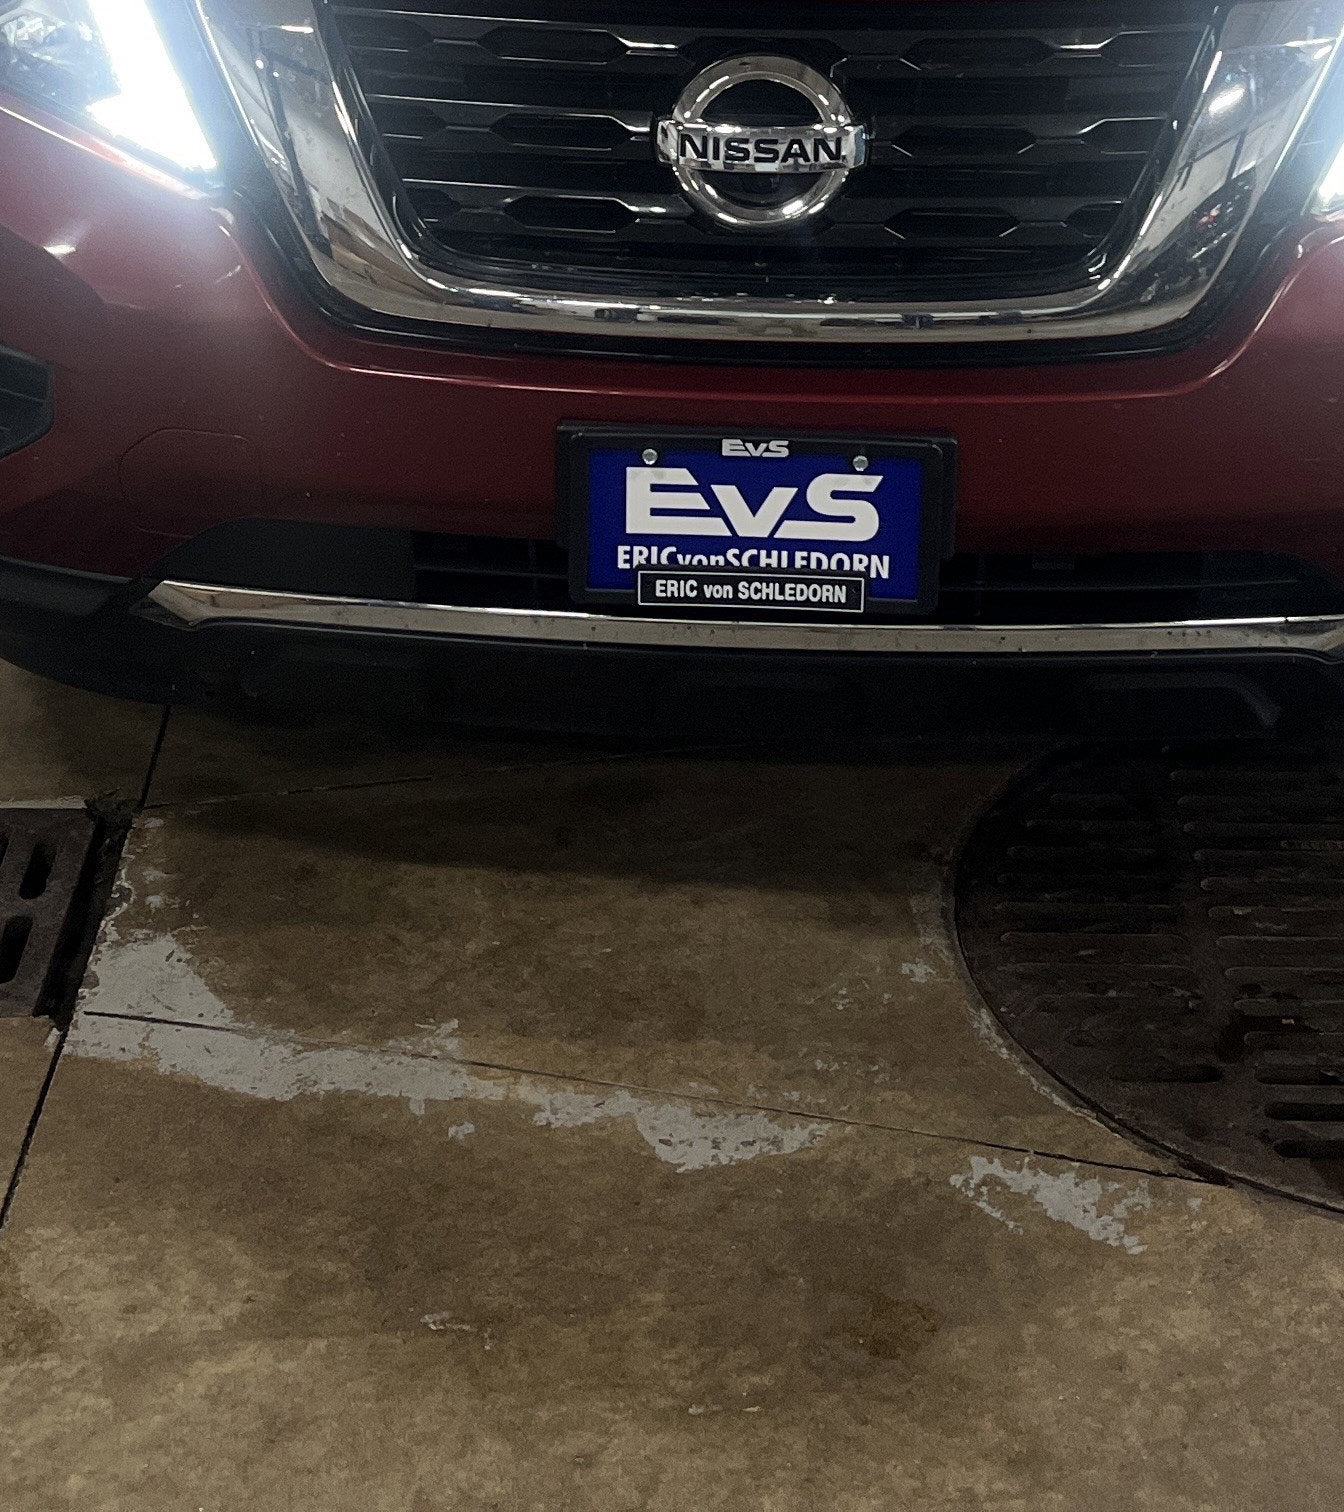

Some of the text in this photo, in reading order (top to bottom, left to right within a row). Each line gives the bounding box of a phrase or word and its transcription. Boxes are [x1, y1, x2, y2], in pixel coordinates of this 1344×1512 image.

[679, 132, 842, 163] NISSAN
[655, 579, 846, 604] ERIC von SCHLEDORN
